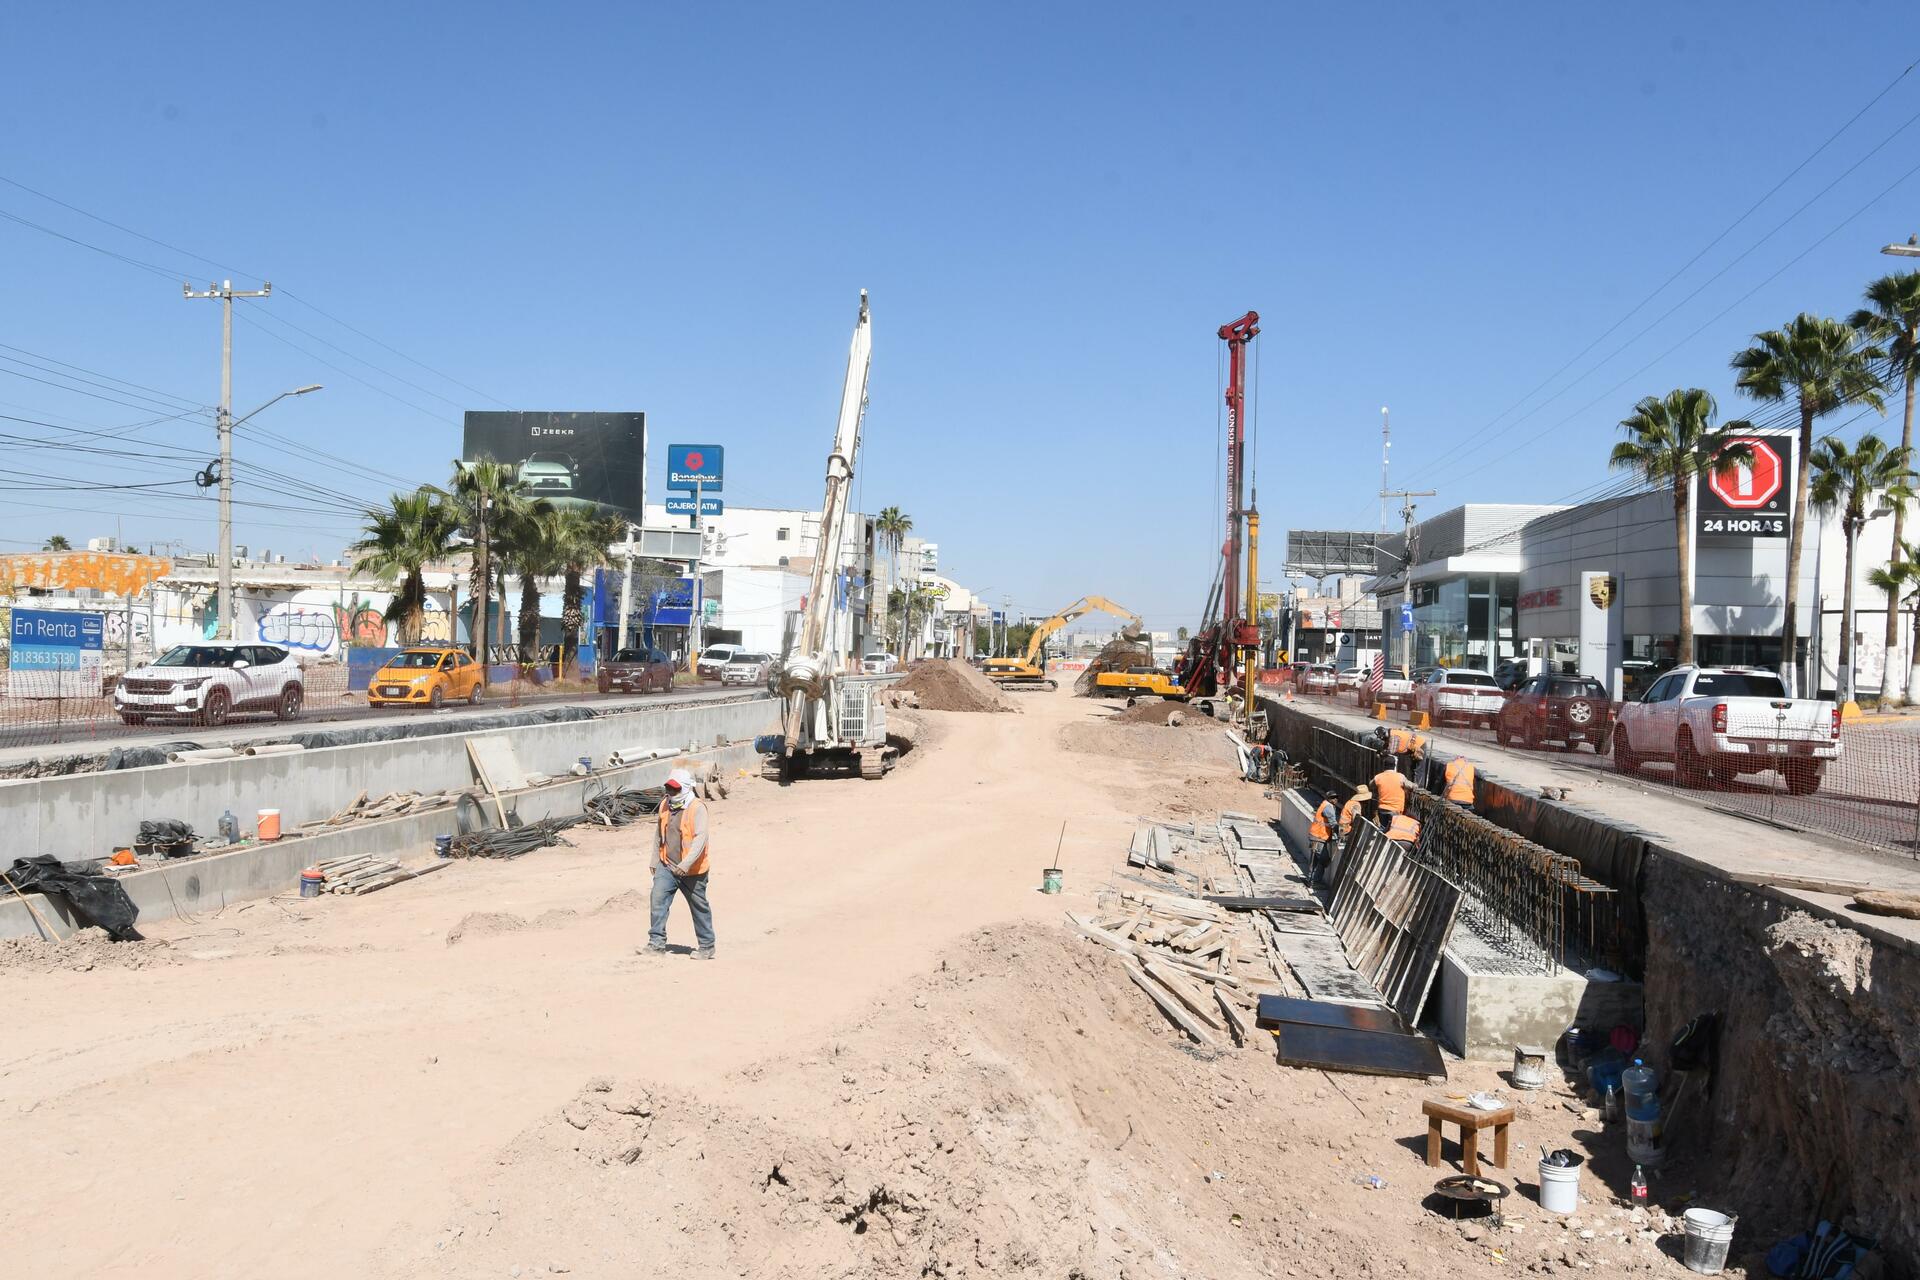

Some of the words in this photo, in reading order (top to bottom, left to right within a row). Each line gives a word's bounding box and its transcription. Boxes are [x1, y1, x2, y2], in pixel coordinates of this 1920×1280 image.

[667, 501, 697, 510] CAJERO
[701, 502, 718, 510] ATM
[1703, 519, 1724, 532] 24
[1727, 519, 1784, 532] HORAS
[15, 618, 33, 635] En
[37, 619, 77, 638] Renta
